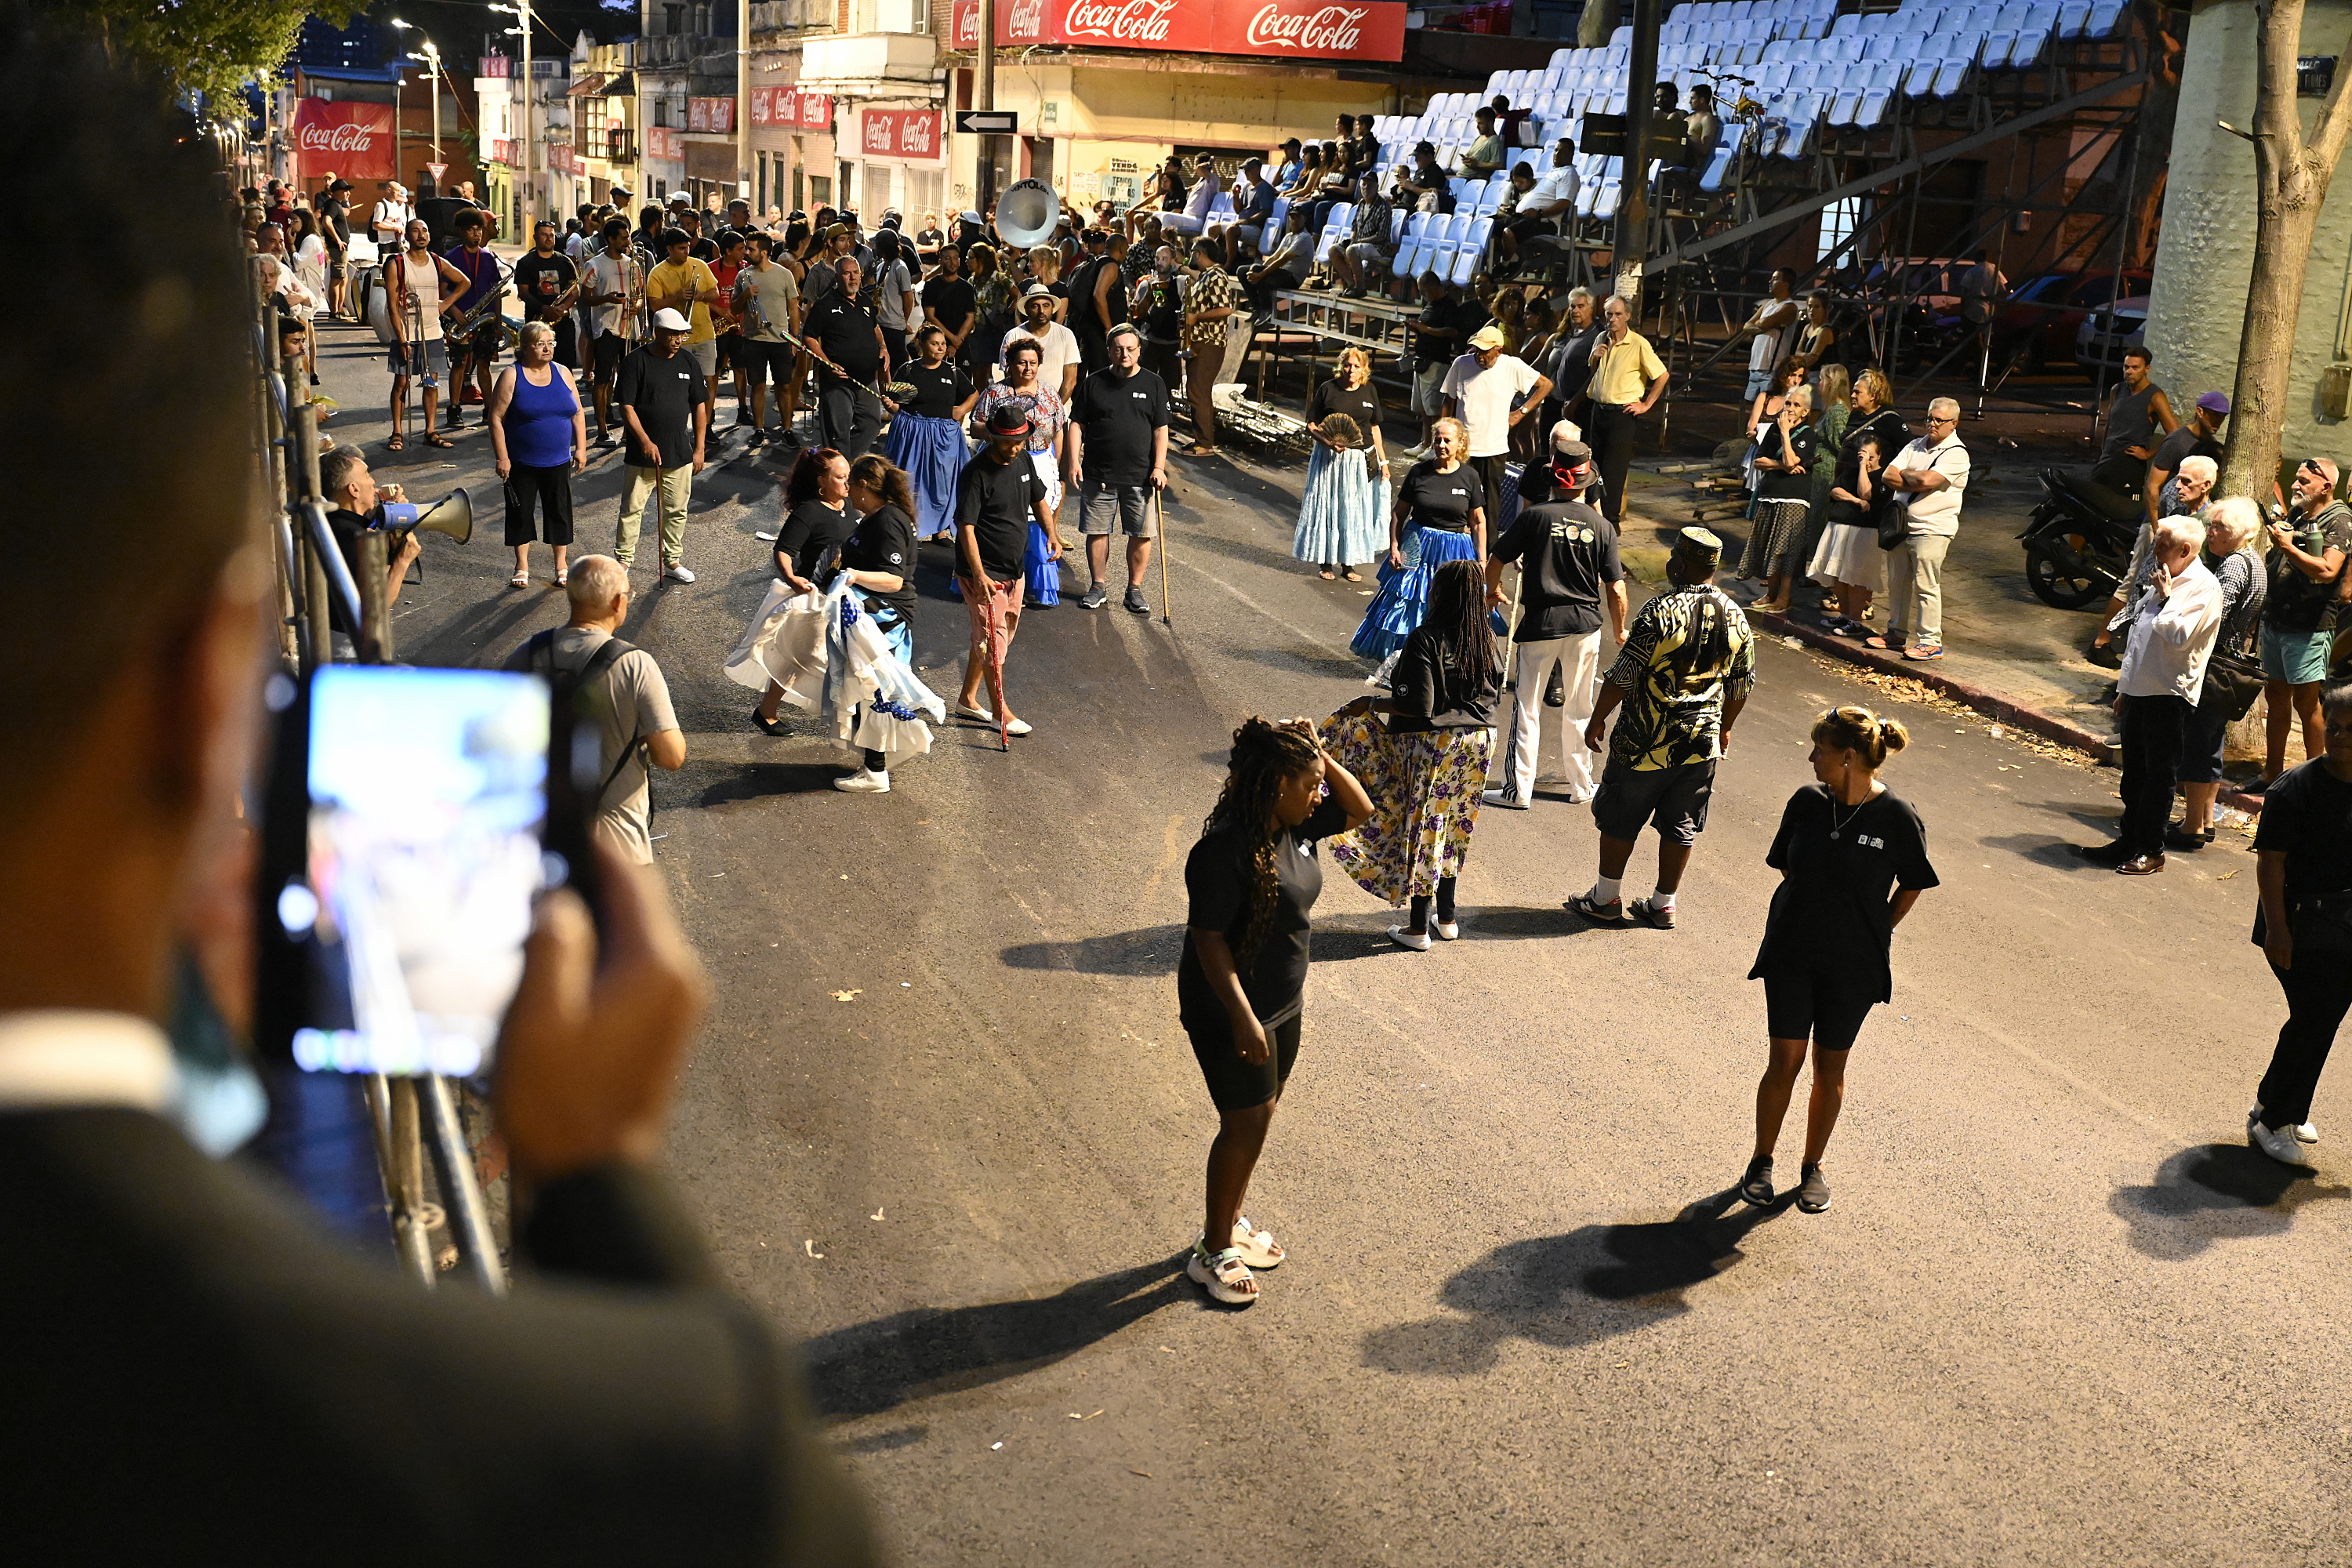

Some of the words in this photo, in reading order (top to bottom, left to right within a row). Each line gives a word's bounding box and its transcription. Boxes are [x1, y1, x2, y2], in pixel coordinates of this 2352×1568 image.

[1009, 0, 1044, 38] Coca-Cola
[1065, 0, 1178, 40] Coca-Cola
[1247, 3, 1370, 50] Coca-Cola
[775, 90, 796, 121] Coca-Cola
[803, 93, 825, 123] Coca-Cola
[301, 122, 376, 151] Coca-Cola
[867, 115, 893, 150] Coca-Cola
[902, 116, 932, 152] Coca-Cola
[1011, 180, 1050, 195] VENTOLERA
